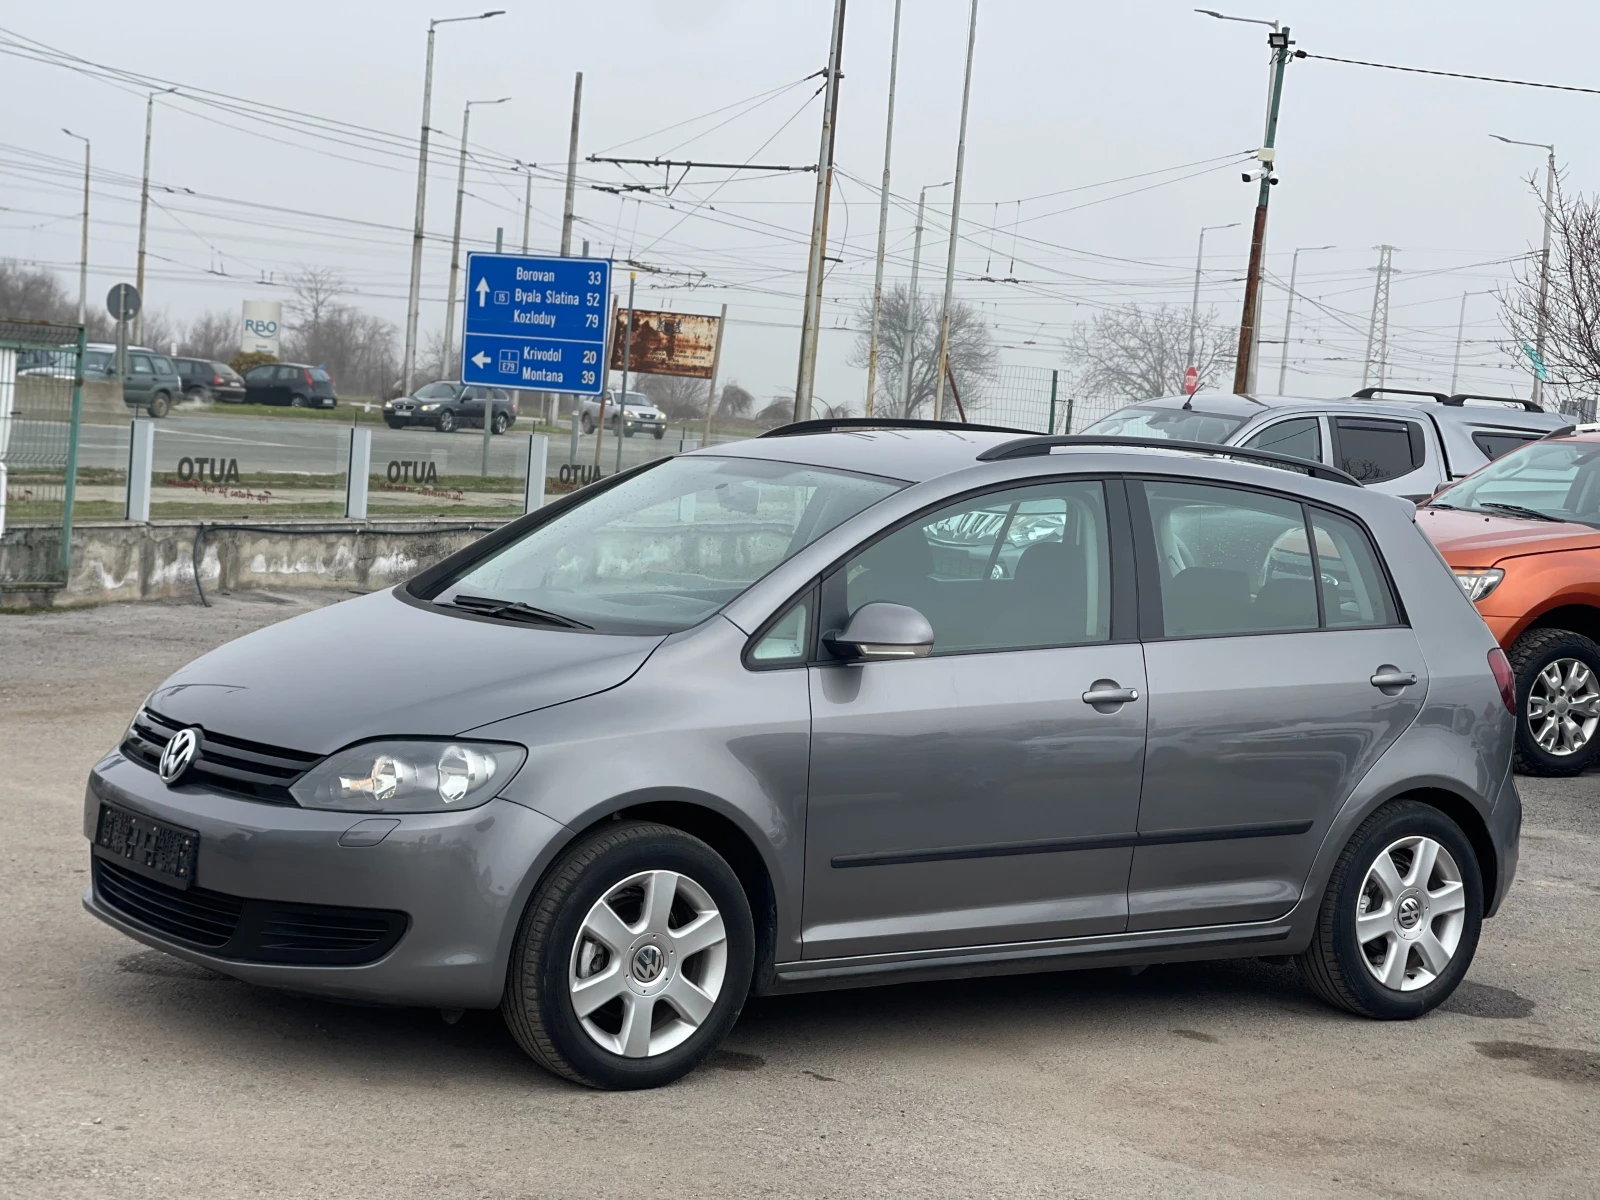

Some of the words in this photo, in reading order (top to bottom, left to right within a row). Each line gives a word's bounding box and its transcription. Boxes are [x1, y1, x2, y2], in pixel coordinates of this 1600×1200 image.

[516, 267, 555, 282] Borovan
[588, 271, 601, 285] 33
[514, 288, 541, 305] Byala
[545, 290, 580, 306] Slatina
[586, 293, 600, 307] 52
[513, 309, 556, 328] Kozloduy
[585, 314, 599, 328] 79
[245, 319, 277, 338] RBO
[523, 346, 562, 362] Krivodol
[582, 351, 597, 365] 20
[502, 362, 515, 371] E79
[522, 367, 564, 383] Montana
[581, 371, 596, 385] 39
[1185, 375, 1197, 386] STOP
